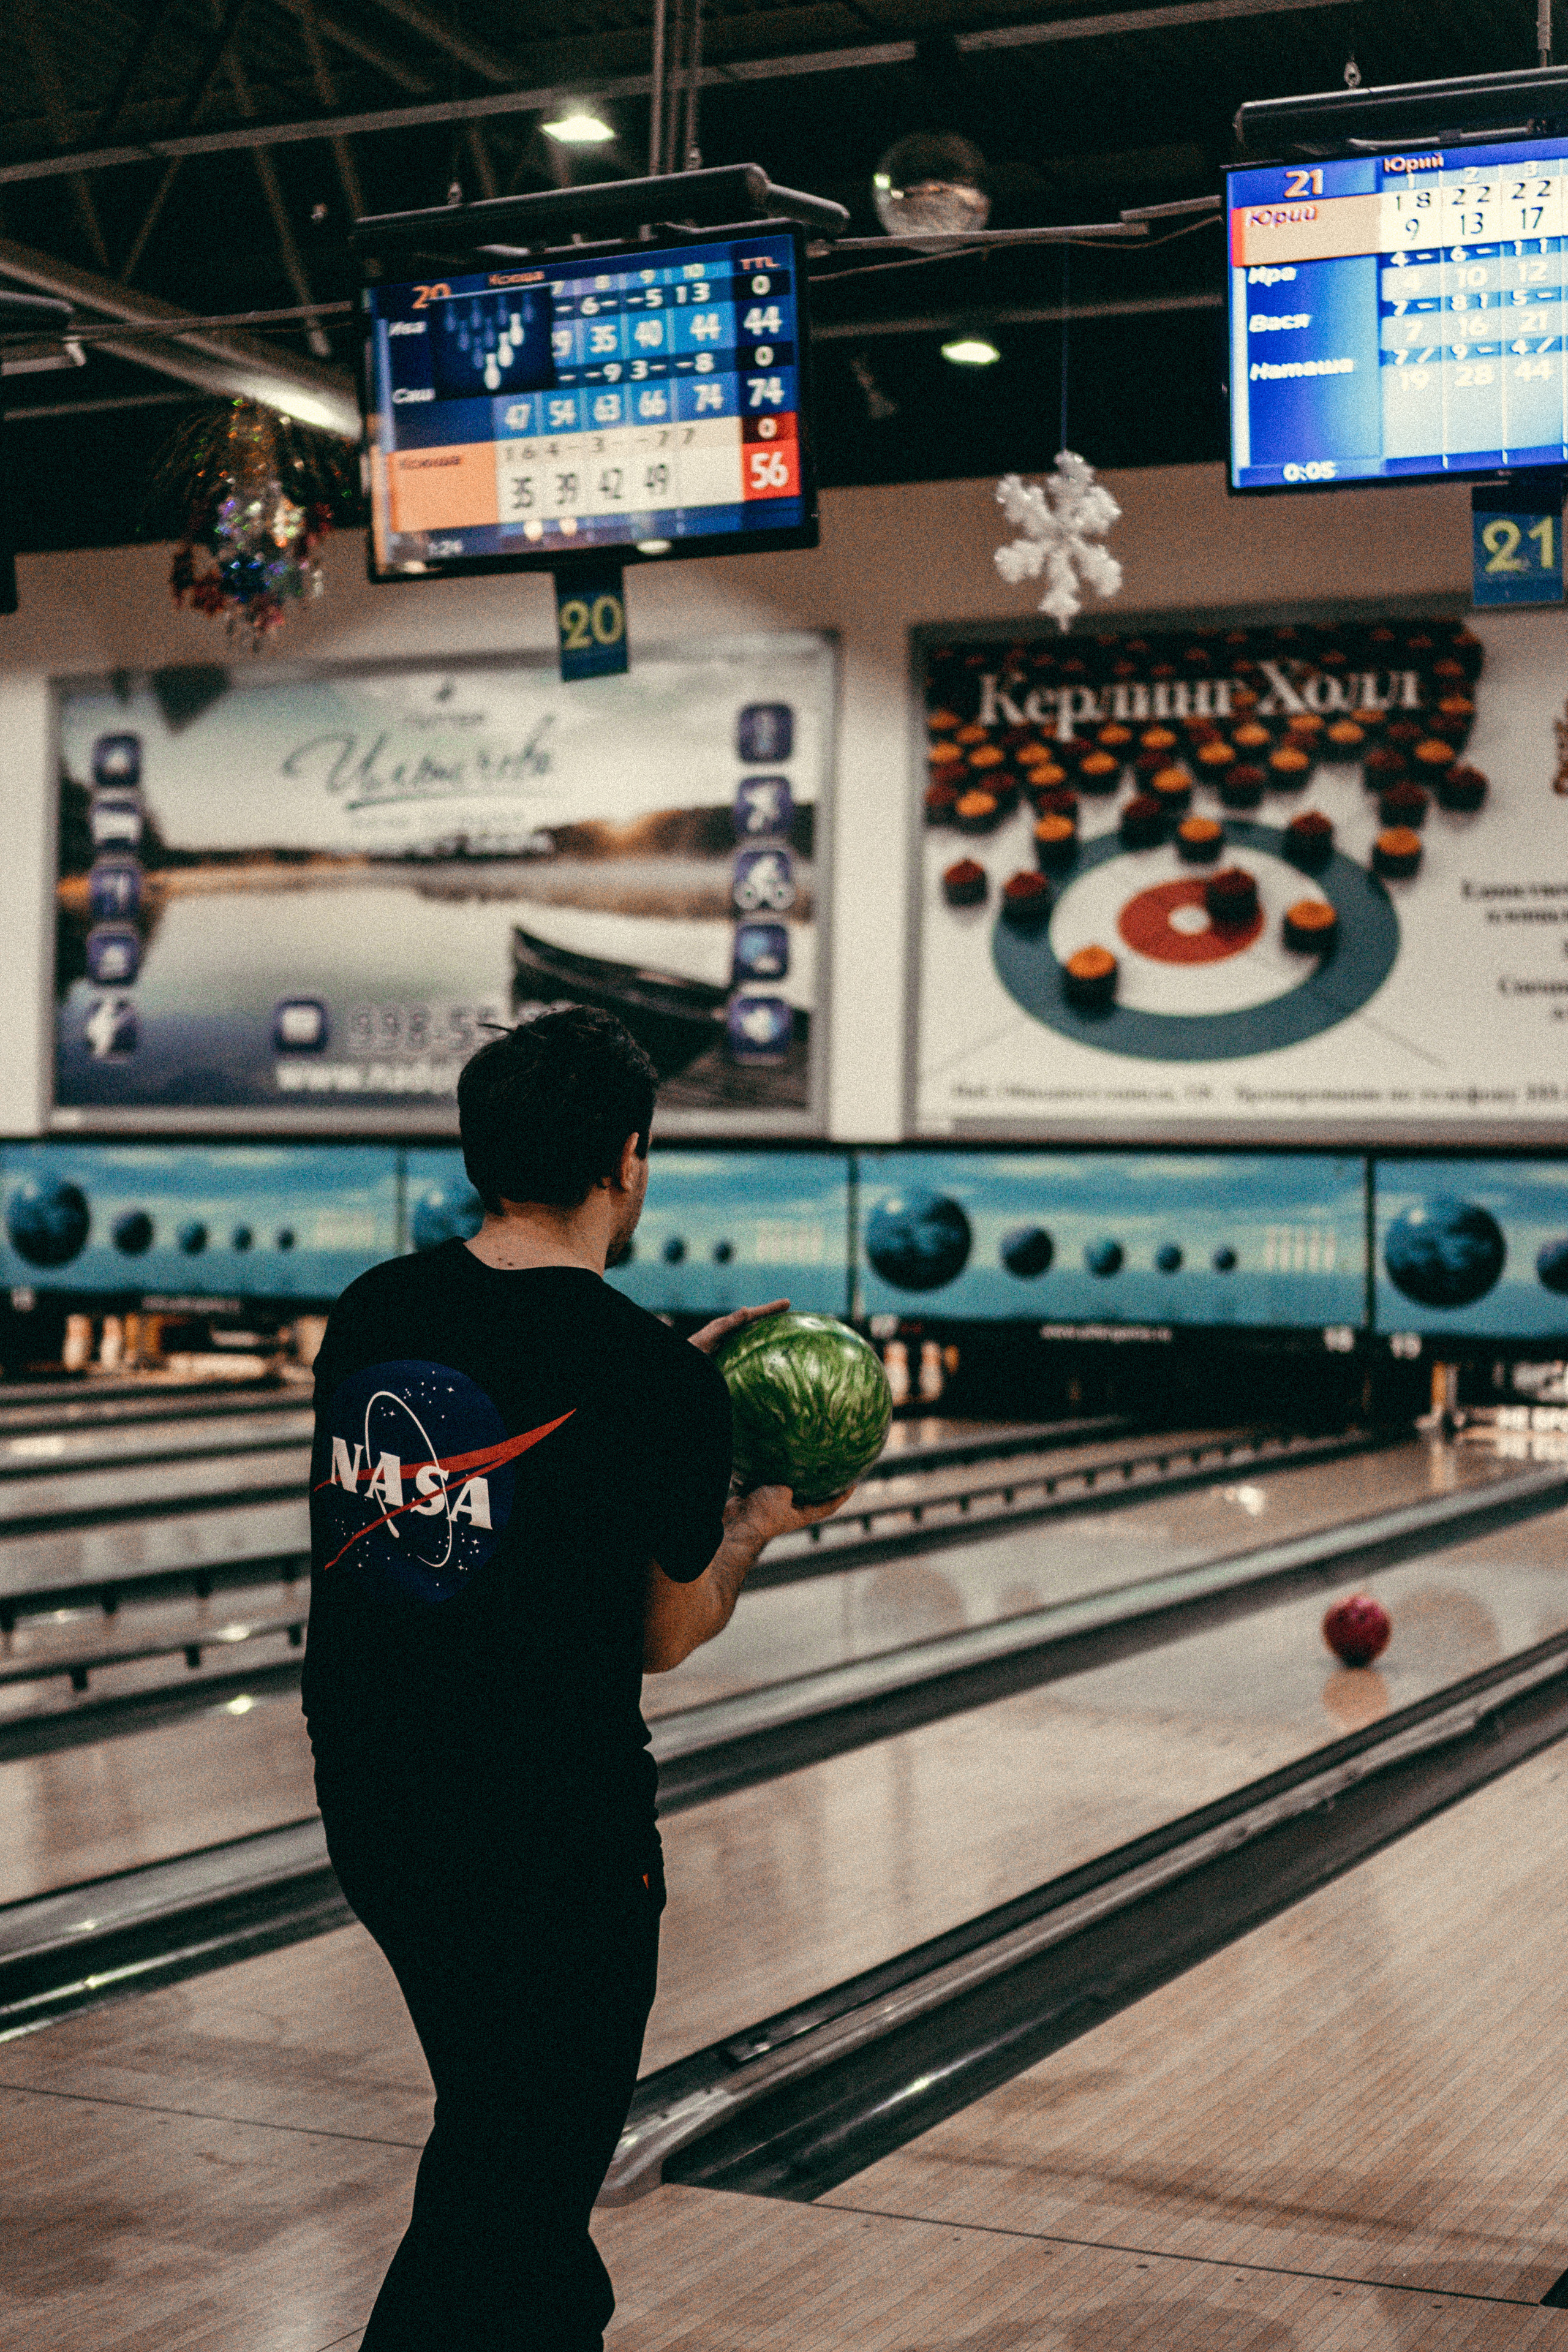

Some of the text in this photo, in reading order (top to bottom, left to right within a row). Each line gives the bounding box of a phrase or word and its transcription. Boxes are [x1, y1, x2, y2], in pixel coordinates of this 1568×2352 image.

[1384, 152, 1444, 173] Юрий
[1283, 168, 1325, 198] 21
[1416, 191, 1431, 208] 8
[1451, 188, 1466, 205] 2
[1477, 186, 1491, 203] 2
[1511, 182, 1526, 200] 2
[1536, 180, 1551, 197] 2
[1245, 204, 1319, 230] Юрий
[1405, 206, 1544, 241] 9 13 17
[1450, 245, 1468, 262] 6
[751, 274, 771, 296] 0
[1248, 265, 1297, 288] Ира
[1457, 266, 1488, 289] 10
[1517, 260, 1548, 283] 12
[412, 282, 452, 309] 20
[1391, 300, 1409, 317] 7
[1450, 294, 1468, 311] 8
[1511, 289, 1528, 306] 5
[590, 324, 618, 353] 35
[689, 312, 722, 341] 44
[743, 305, 783, 336] 44
[1248, 313, 1312, 333] Вася
[1404, 310, 1548, 342] 7 16 21
[754, 345, 775, 367] 0
[1392, 348, 1409, 366] 7
[1450, 343, 1468, 360] 9
[638, 388, 668, 418] 66
[693, 382, 725, 413] 74
[747, 376, 785, 407] 74
[757, 417, 778, 439] 0
[749, 451, 790, 490] 56
[1283, 460, 1338, 483] 0:05
[1482, 514, 1555, 573] 21
[559, 594, 625, 650] 20
[979, 660, 1421, 742] Керлинг Холл
[330, 1435, 494, 1531] NASA
